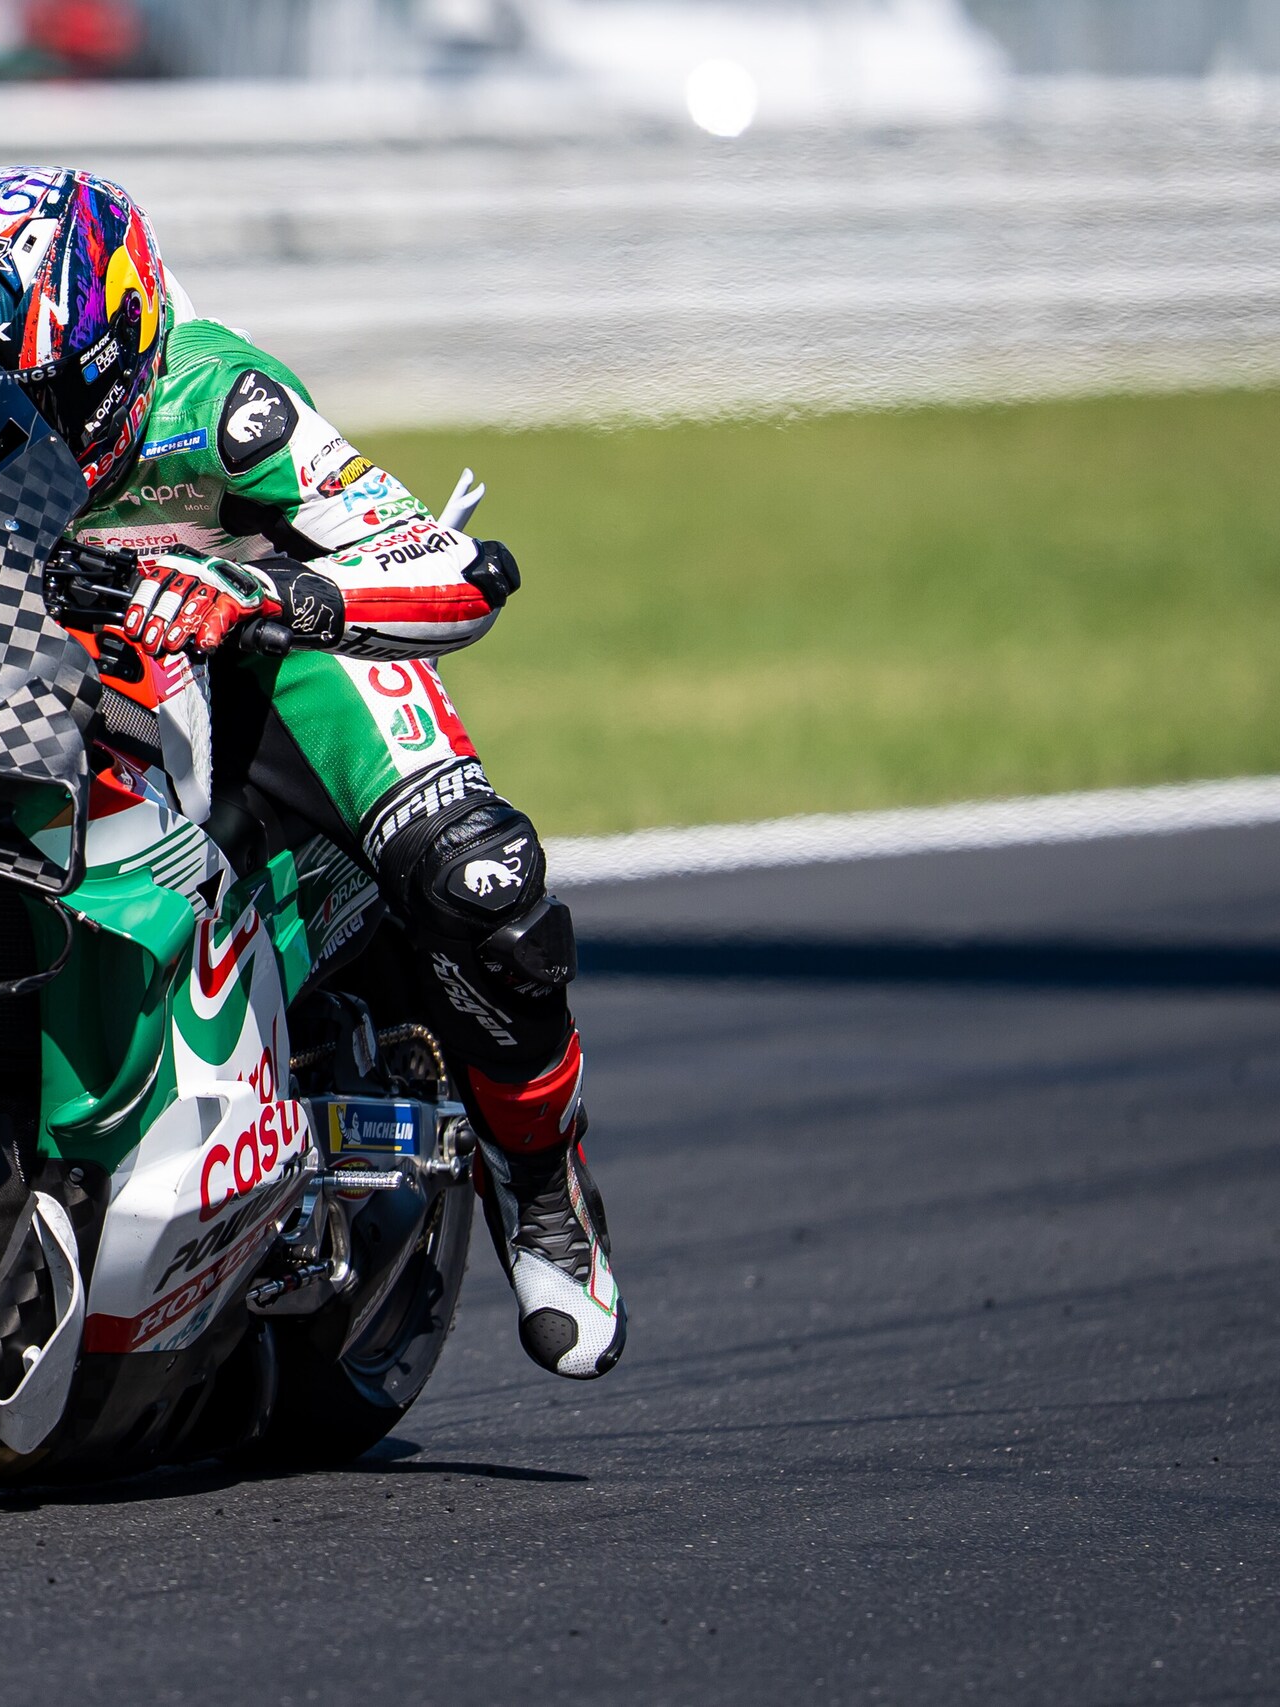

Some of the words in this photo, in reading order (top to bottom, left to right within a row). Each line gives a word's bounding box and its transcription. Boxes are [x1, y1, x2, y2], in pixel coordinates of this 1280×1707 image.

[80, 331, 111, 364] SHARK
[96, 340, 117, 364] QUAD
[98, 346, 120, 373] LOCK
[145, 436, 201, 456] MICHELIN
[140, 483, 206, 505] april
[184, 504, 210, 512] Moto
[106, 533, 179, 549] Castrol
[331, 870, 372, 914] DRAC
[362, 1121, 414, 1140] MICHELIN
[199, 1101, 308, 1222] Castr
